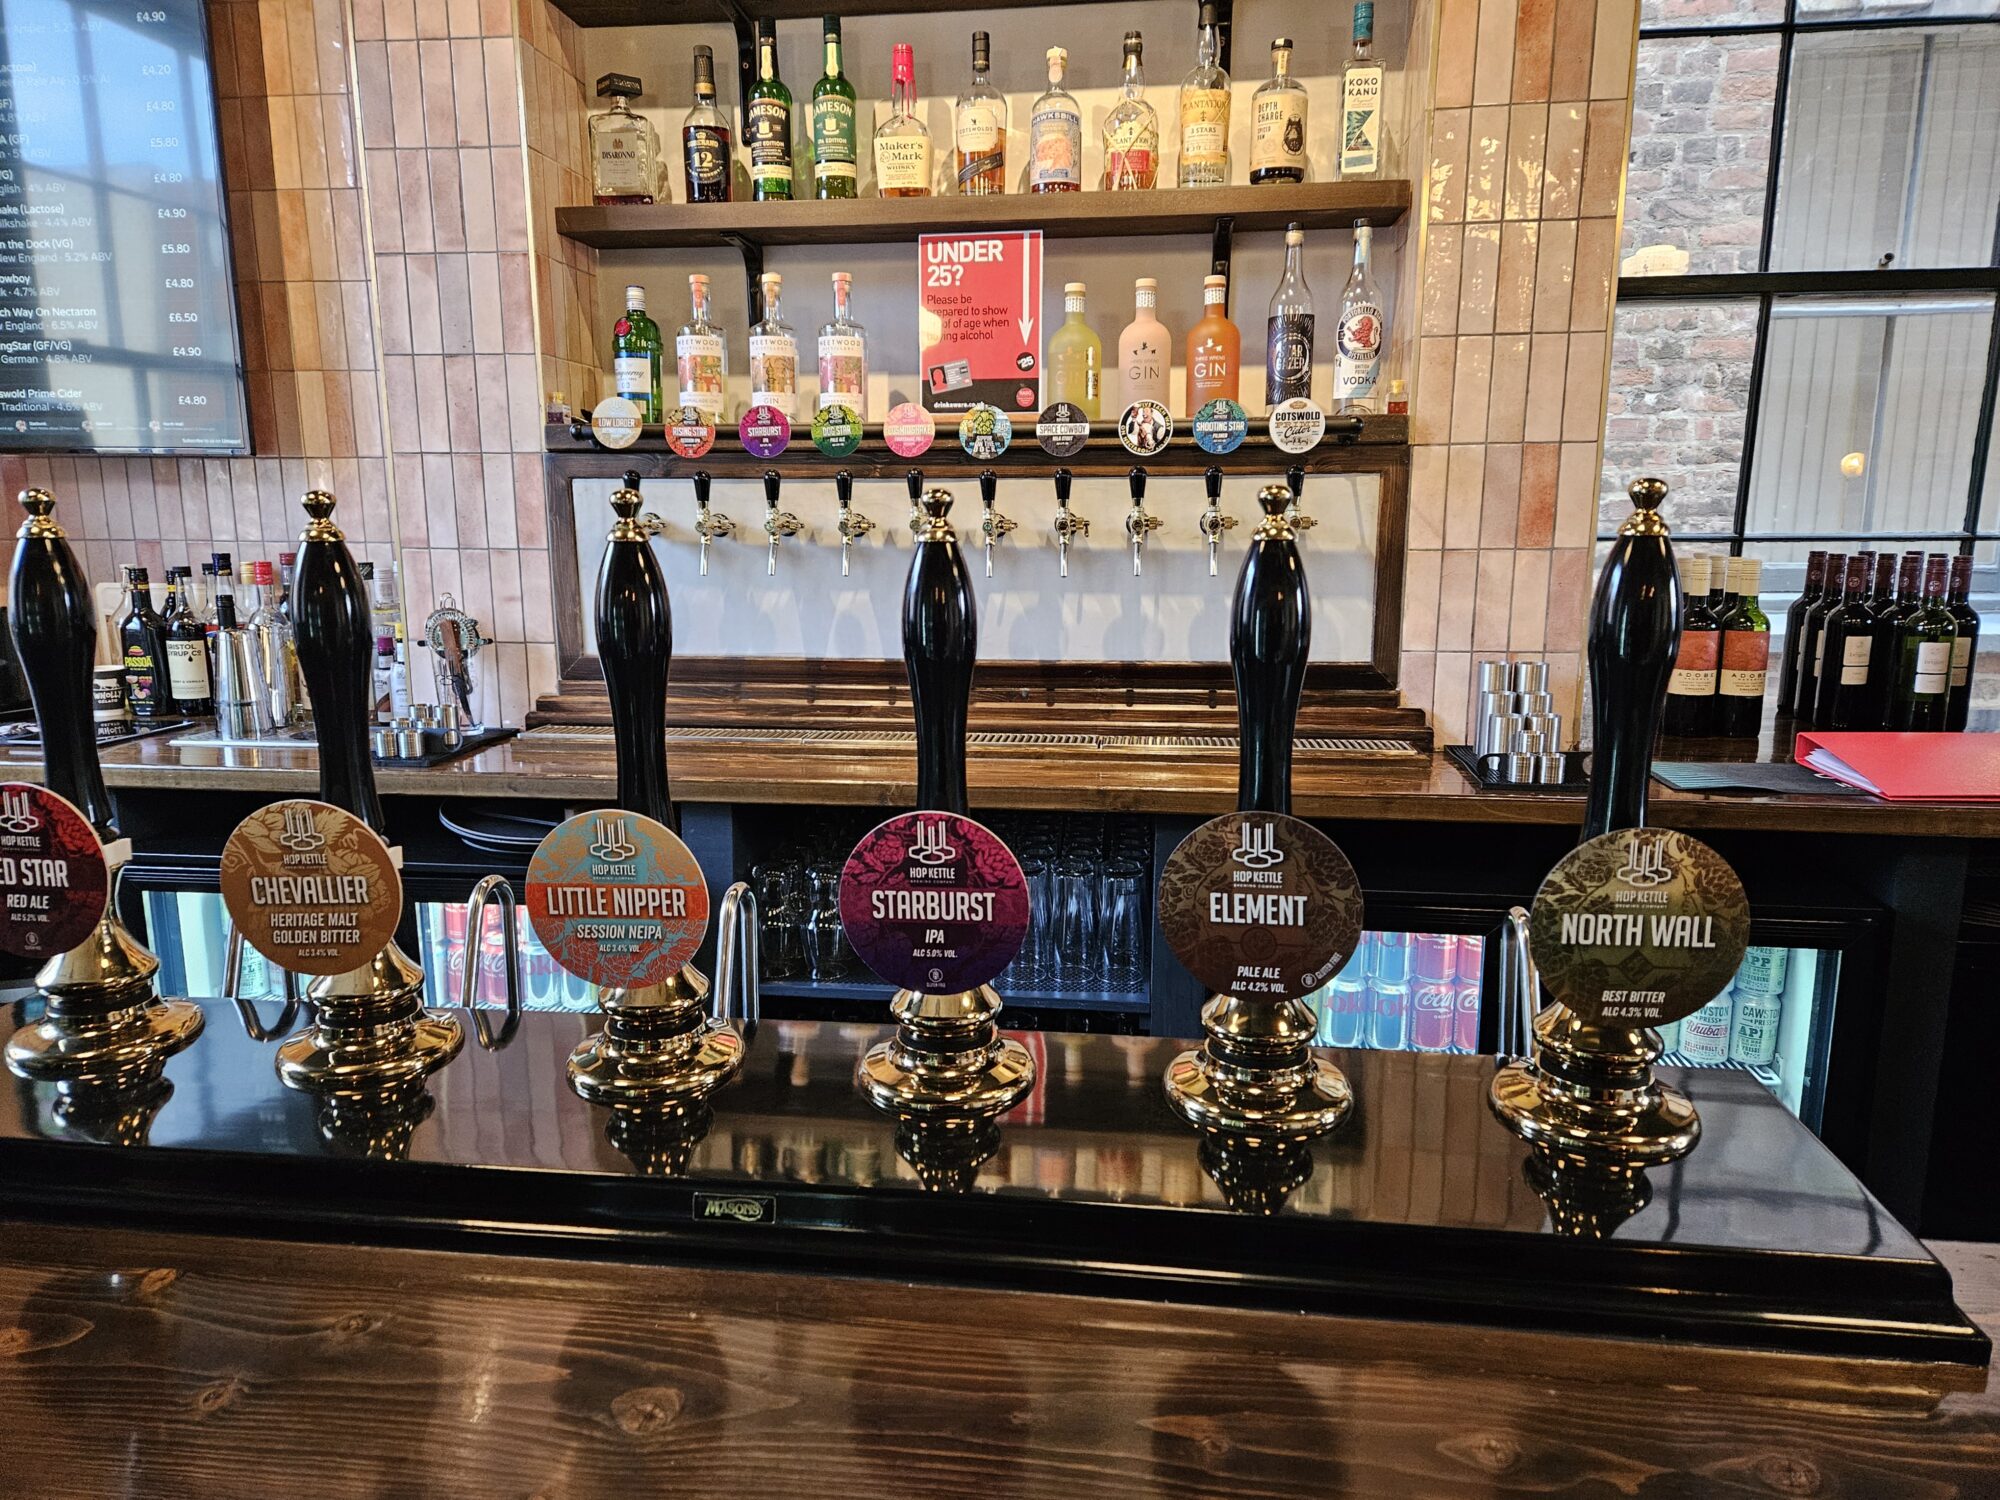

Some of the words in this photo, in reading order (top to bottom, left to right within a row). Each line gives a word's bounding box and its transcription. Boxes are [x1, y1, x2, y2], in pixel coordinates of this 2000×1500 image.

[136, 11, 166, 22] £4.90
[143, 64, 171, 75] £4.20
[1349, 77, 1378, 87] KOKO
[1348, 87, 1378, 97] KANU
[146, 101, 175, 112] £4.80
[814, 101, 852, 119] JAMESON
[1258, 101, 1278, 114] DEPTH
[749, 104, 786, 122] JAMESON
[1257, 110, 1284, 124] CHARGE
[1195, 126, 1217, 134] STARS
[150, 137, 178, 148] £5.80
[880, 142, 924, 151] Maker's
[602, 151, 636, 160] DISARONNO
[692, 151, 713, 168] 12
[892, 152, 922, 161] Mark
[154, 173, 182, 184] £4.80
[46, 184, 66, 193] ABV
[20, 203, 64, 215] (Lactose)
[158, 208, 187, 219] £4.90
[44, 218, 68, 228] 4.4%
[71, 218, 92, 228] ABV
[7, 240, 24, 250] the
[26, 239, 50, 250] Dock
[51, 238, 74, 250] (VG)
[161, 244, 190, 254] £5.80
[927, 239, 1004, 263] UNDER
[18, 253, 57, 265] England
[64, 253, 88, 263] 5.2%
[91, 252, 112, 262] ABV
[927, 265, 964, 288] 25?
[165, 278, 194, 288] £4.80
[13, 287, 37, 298] 4.7%
[39, 287, 60, 297] ABV
[927, 294, 959, 305] Please
[960, 293, 972, 304] be
[12, 307, 33, 319] Way
[35, 307, 50, 317] On
[52, 307, 96, 317] Nectaron
[971, 306, 980, 316] to
[982, 305, 1008, 316] show
[169, 313, 198, 323] £6.50
[953, 319, 962, 328] of
[964, 320, 981, 331] age
[983, 317, 1010, 328] when
[5, 320, 44, 332] England
[51, 321, 76, 331] 6.5%
[77, 320, 99, 330] ABV
[960, 330, 994, 341] alcohol
[33, 340, 72, 352] (GF/VG)
[172, 346, 202, 357] £4.90
[1, 354, 39, 364] German
[45, 354, 70, 364] 4.8%
[71, 354, 93, 364] ABV
[1128, 366, 1160, 380] GIN
[1194, 363, 1227, 378] GIN
[1343, 376, 1377, 386] VODKA
[28, 388, 55, 399] Prime
[57, 388, 82, 399] Cider
[178, 395, 207, 406] £4.80
[763, 397, 780, 405] GIN
[1, 402, 50, 412] Traditional
[56, 402, 81, 412] 4.6%
[82, 402, 104, 412] ABV
[1275, 411, 1321, 421] COTSWOLD
[598, 418, 612, 428] LOW
[612, 418, 635, 428] LOADER
[1039, 424, 1058, 434] SPACE
[1059, 424, 1086, 434] COWBOY
[1196, 421, 1228, 432] SHOOTING
[1228, 420, 1245, 431] STAR
[747, 425, 782, 438] STARBURST
[1284, 426, 1312, 439] Cider
[94, 690, 122, 699] WHOLLY
[1, 835, 16, 847] HOP
[17, 835, 41, 847] KETTLE
[283, 853, 301, 865] HOP
[301, 853, 328, 865] KETTLE
[20, 858, 70, 888] STAR
[592, 863, 610, 876] HOP
[610, 864, 636, 876] KETTLE
[910, 867, 928, 879] HOP
[928, 867, 955, 879] KETTLE
[1233, 870, 1252, 883] HOP
[1253, 871, 1283, 884] KETTLE
[250, 875, 370, 905] CHEVALLIER
[7, 893, 28, 909] RED
[29, 895, 50, 909] ALE
[546, 886, 608, 916] LITTLE
[612, 887, 686, 917] NIPPER
[1615, 890, 1636, 903] HOP
[1637, 891, 1668, 903] KETTLE
[872, 890, 996, 922] STARBURST
[1209, 892, 1308, 927] ELEMENT
[11, 913, 22, 922] ALC
[22, 913, 37, 922] 5.2%
[270, 912, 325, 927] HERITAGE
[328, 912, 358, 927] MALT
[273, 929, 319, 944] GOLDEN
[320, 929, 360, 944] BITTER
[577, 924, 626, 939] SESSION
[628, 925, 662, 940] NEIPA
[925, 929, 945, 944] IPA
[1561, 913, 1644, 946] NORTH
[1651, 915, 1716, 948] WALL
[298, 948, 310, 957] ALC
[310, 948, 327, 957] 3.4%
[599, 944, 611, 952] ALC
[611, 944, 628, 953] 3.4%
[912, 949, 926, 957] ALC
[926, 949, 943, 958] 5.0%
[944, 949, 958, 958] VOL.
[1237, 965, 1260, 978] PALE
[1262, 967, 1280, 979] ALE
[1316, 963, 1333, 980] GLUTEN
[1331, 952, 1343, 968] FREE
[1231, 981, 1247, 991] ALC
[1247, 982, 1268, 993] 4.2%
[1270, 983, 1288, 993] VOL.
[1602, 990, 1627, 1002] BEST
[1629, 991, 1666, 1004] BITTER
[1602, 1007, 1619, 1017] ALC
[1620, 1007, 1642, 1017] 4.3%
[1644, 1008, 1663, 1018] VOL.
